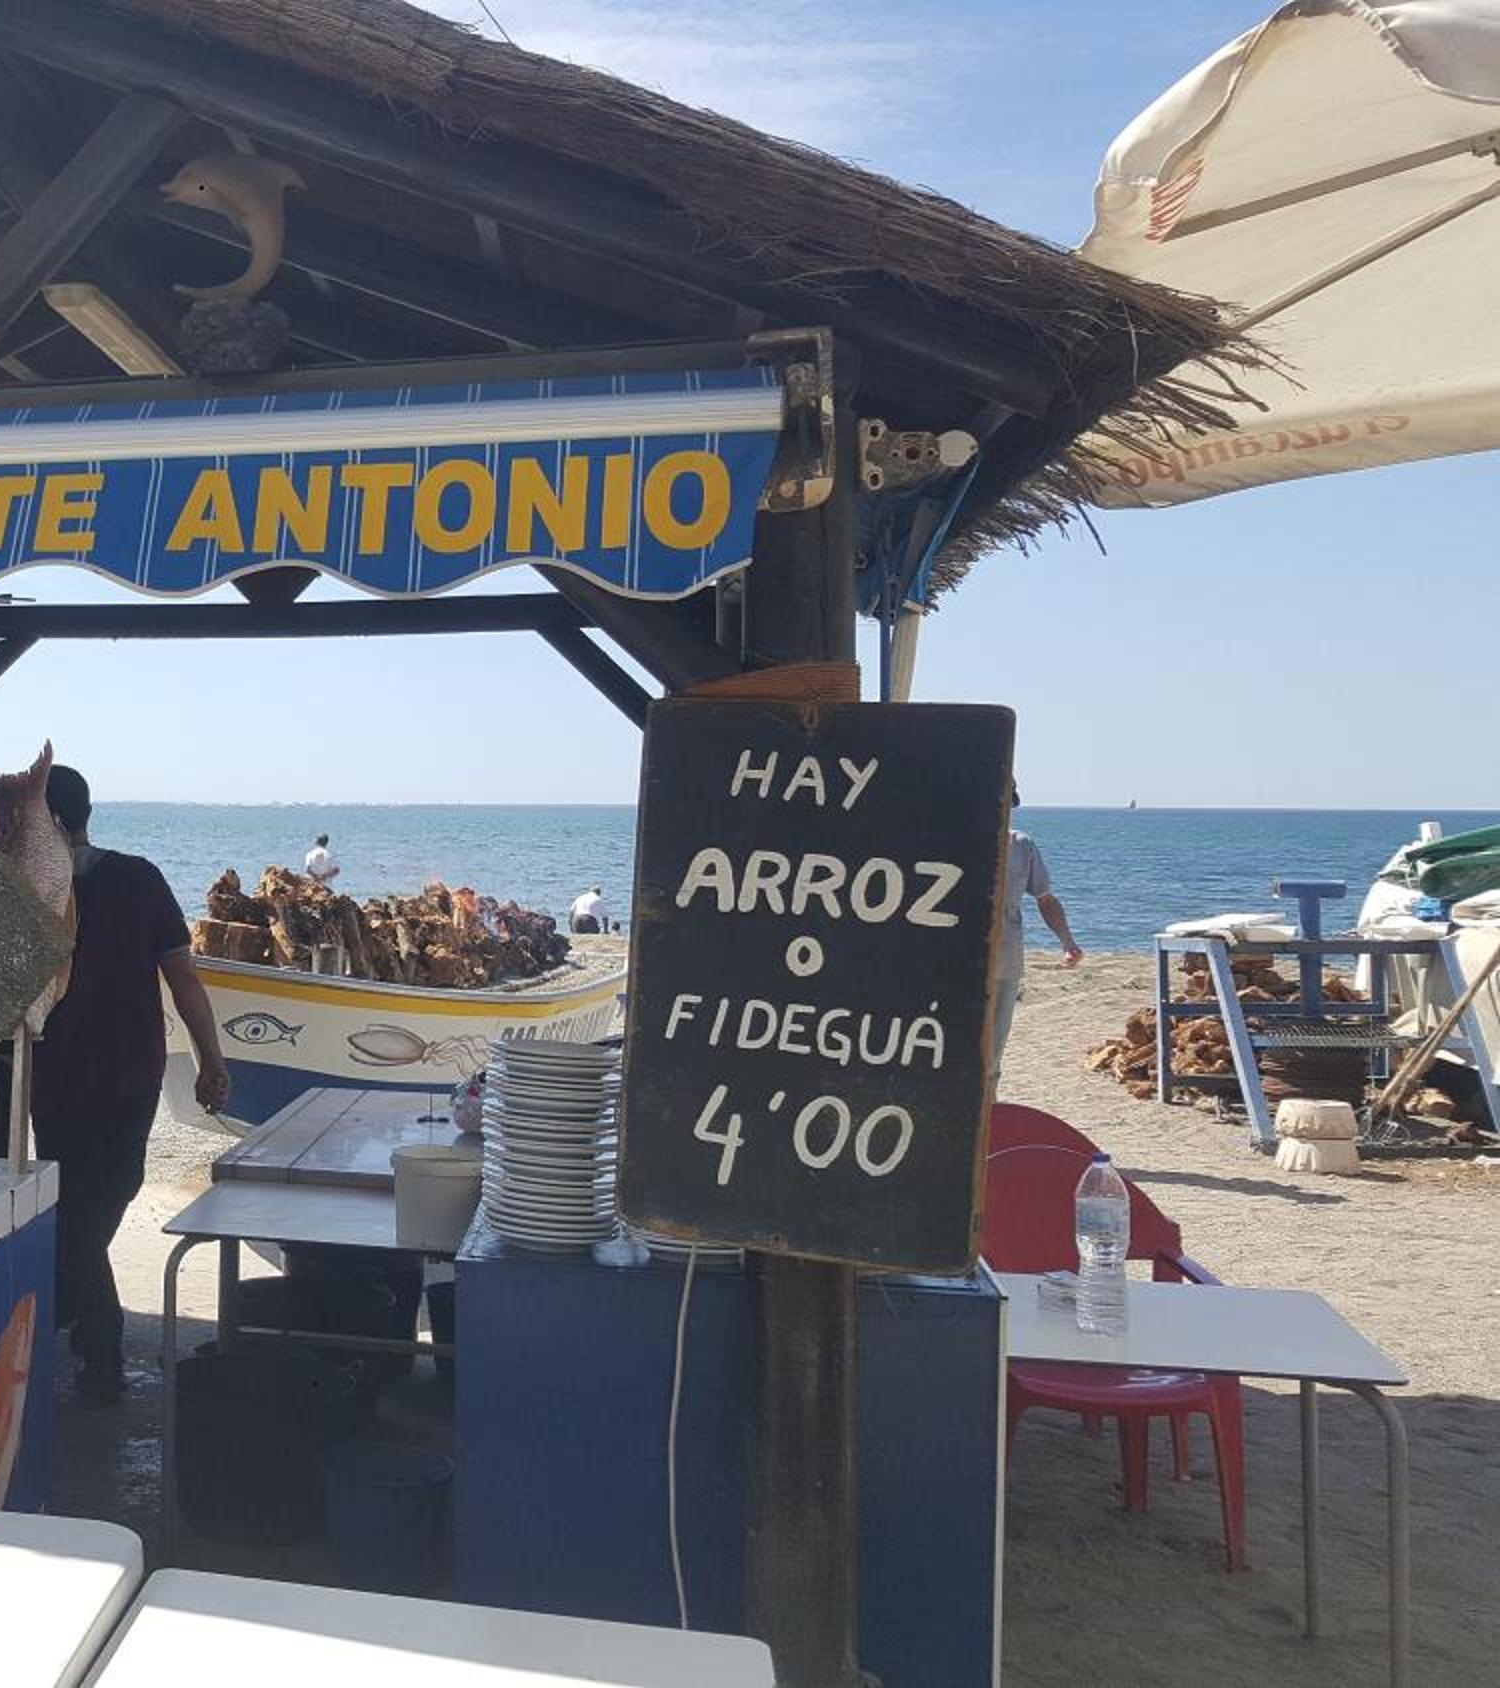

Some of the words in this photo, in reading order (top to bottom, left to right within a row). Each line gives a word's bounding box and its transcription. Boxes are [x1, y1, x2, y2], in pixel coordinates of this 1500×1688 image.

[165, 450, 731, 555] ANTONIO
[730, 749, 878, 810] HAY
[675, 847, 964, 929] ARROZ
[664, 993, 944, 1070] FIDEGUÁ
